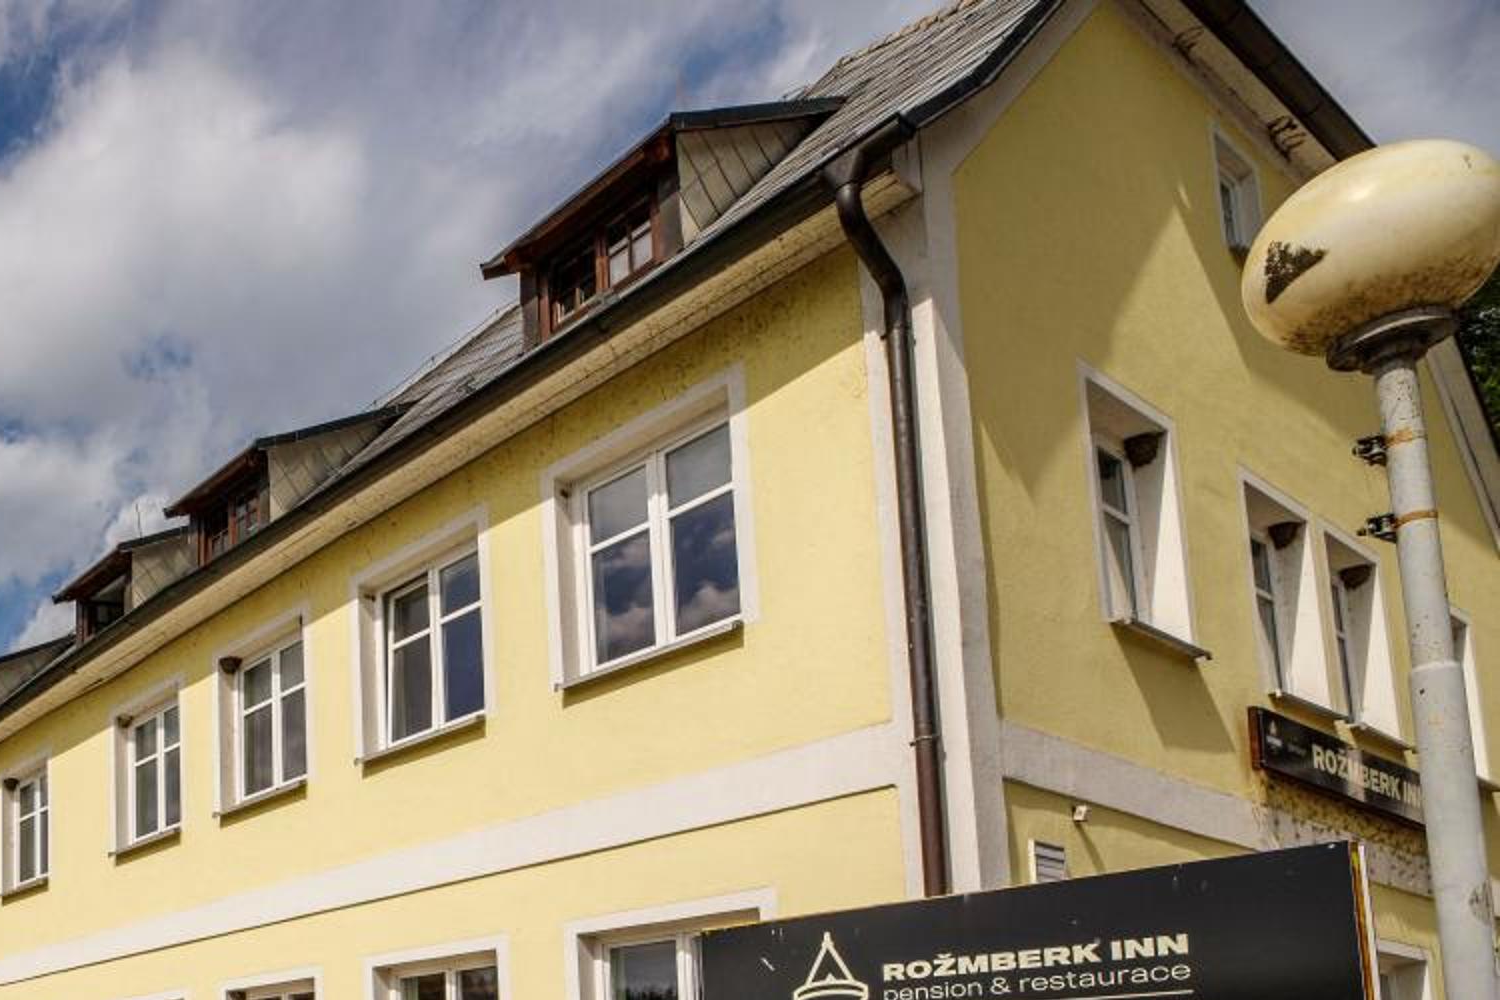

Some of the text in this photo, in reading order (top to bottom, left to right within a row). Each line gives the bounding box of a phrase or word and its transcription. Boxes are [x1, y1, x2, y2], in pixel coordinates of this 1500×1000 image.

[882, 933, 1189, 981] ROŽMBERK INN
[990, 977, 1011, 995] &
[1018, 963, 1192, 993] restaurace
